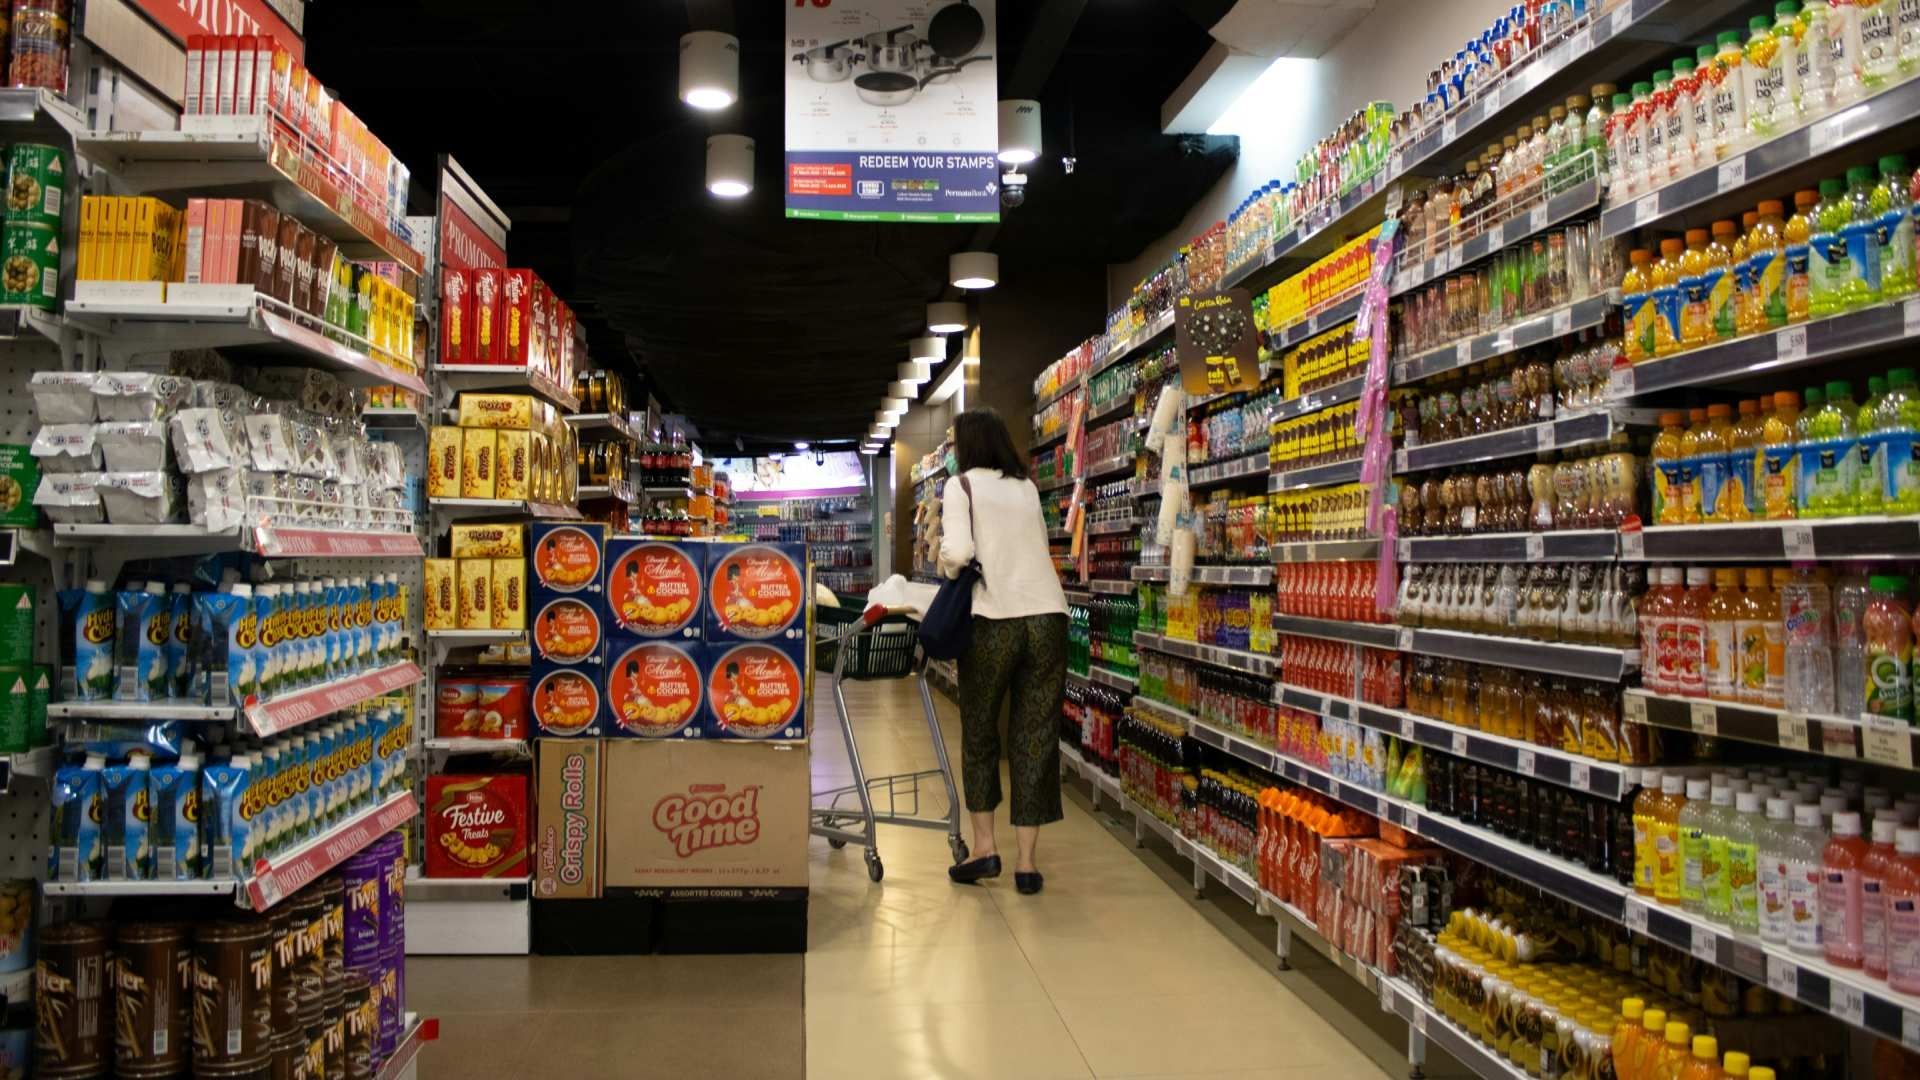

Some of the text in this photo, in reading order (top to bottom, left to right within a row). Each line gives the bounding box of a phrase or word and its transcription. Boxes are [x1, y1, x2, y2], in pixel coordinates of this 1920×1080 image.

[859, 156, 994, 169] REDEEM YOUR STAMPS
[656, 587, 690, 595] COOKIES
[442, 802, 504, 830] Festive
[560, 754, 588, 885] Crispy Rolls
[653, 785, 760, 832] Good
[326, 826, 370, 863] PROMOTION
[461, 827, 489, 841] Treats
[669, 817, 760, 859] Time
[670, 889, 743, 897] ASSORTED COOKIES
